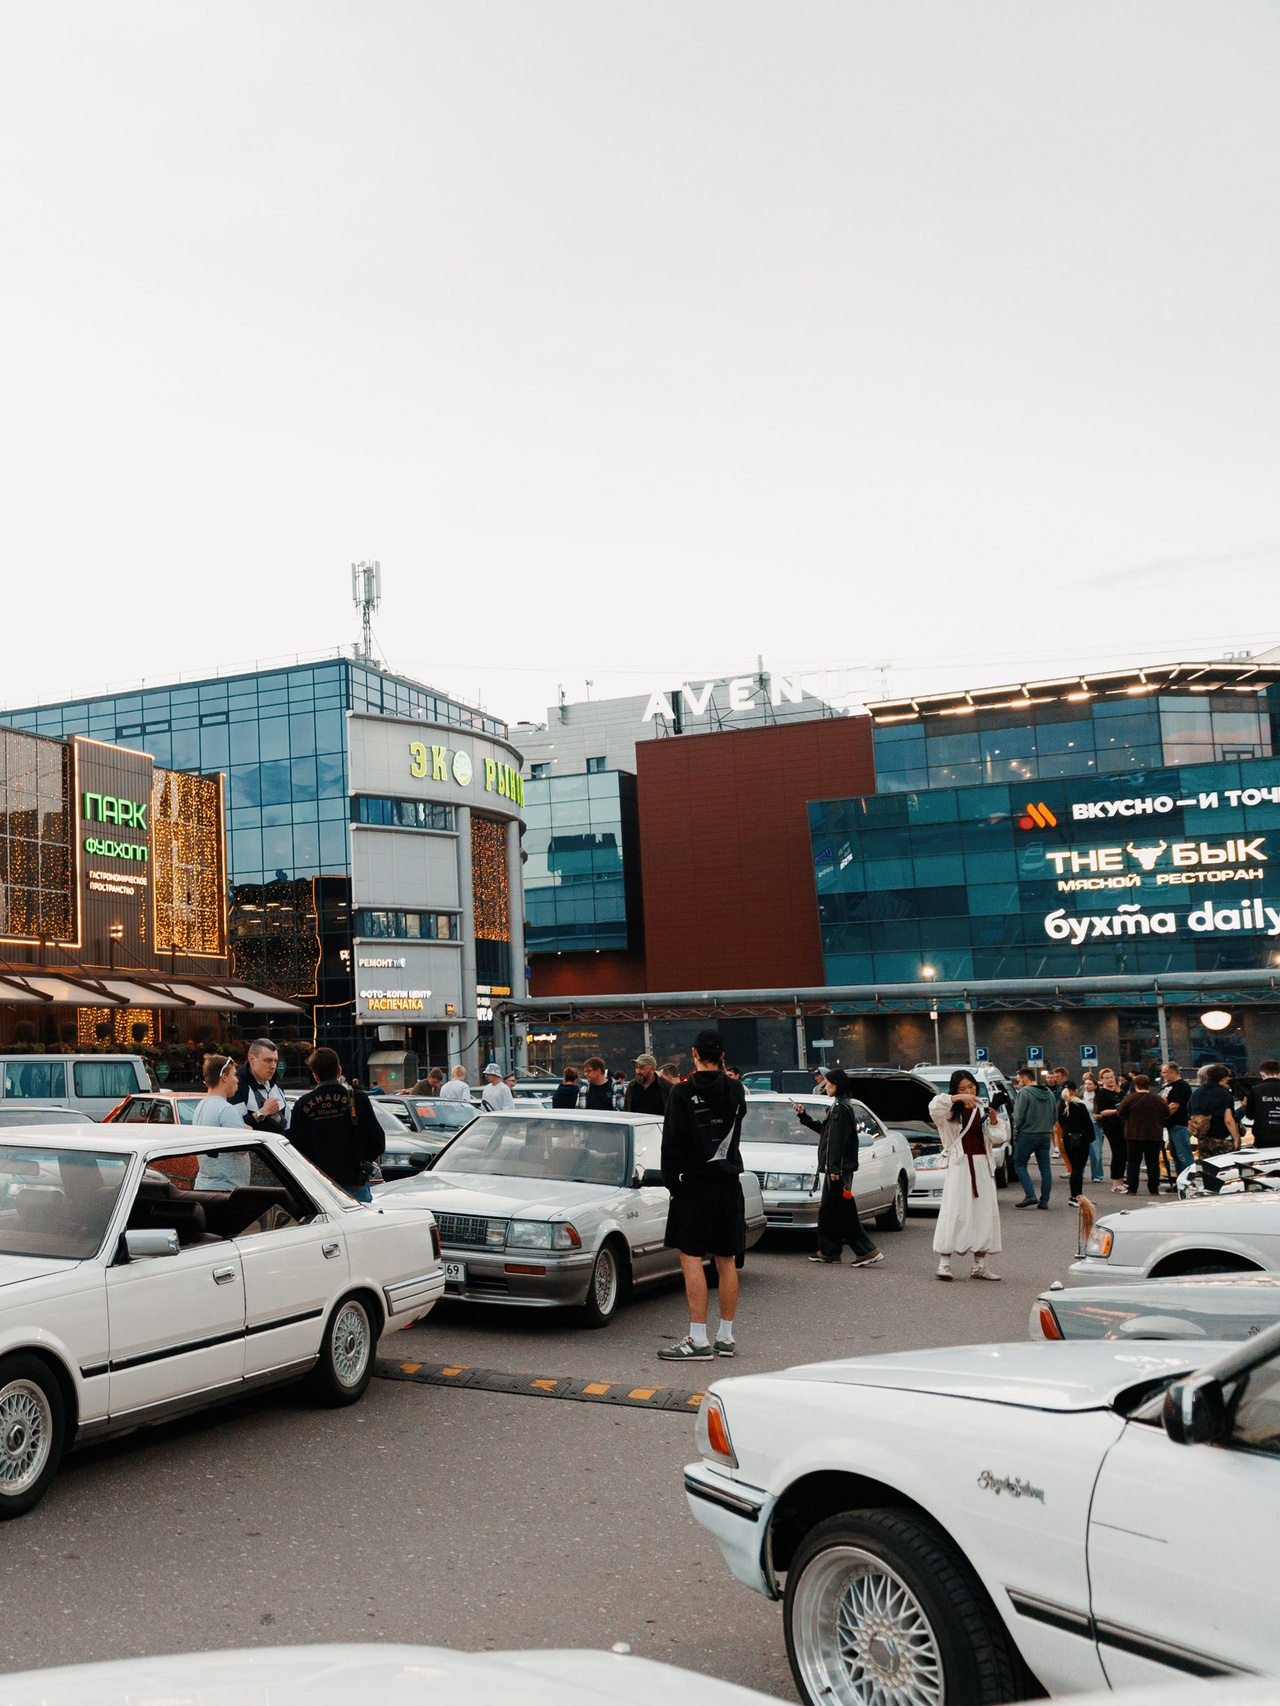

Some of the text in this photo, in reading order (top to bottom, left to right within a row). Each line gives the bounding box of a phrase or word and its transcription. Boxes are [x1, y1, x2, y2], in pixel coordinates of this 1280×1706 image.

[1224, 786, 1280, 807] ТОЧ
[1045, 837, 1268, 874] THE БЫК
[1057, 868, 1264, 892] МЯСНОЙ РЕСТОРАН
[89, 881, 135, 896] ПРОСТРАНСТВО
[1187, 898, 1280, 936] daily
[358, 958, 393, 968] РЕМОНТ
[409, 990, 432, 999] ЦЕНТР
[368, 999, 424, 1010] РАСПЕЧАТКА
[976, 1049, 985, 1059] P
[1030, 1047, 1039, 1058] P
[1084, 1046, 1093, 1057] P
[303, 1094, 350, 1113] EXHAUS
[446, 1264, 459, 1275] 69
